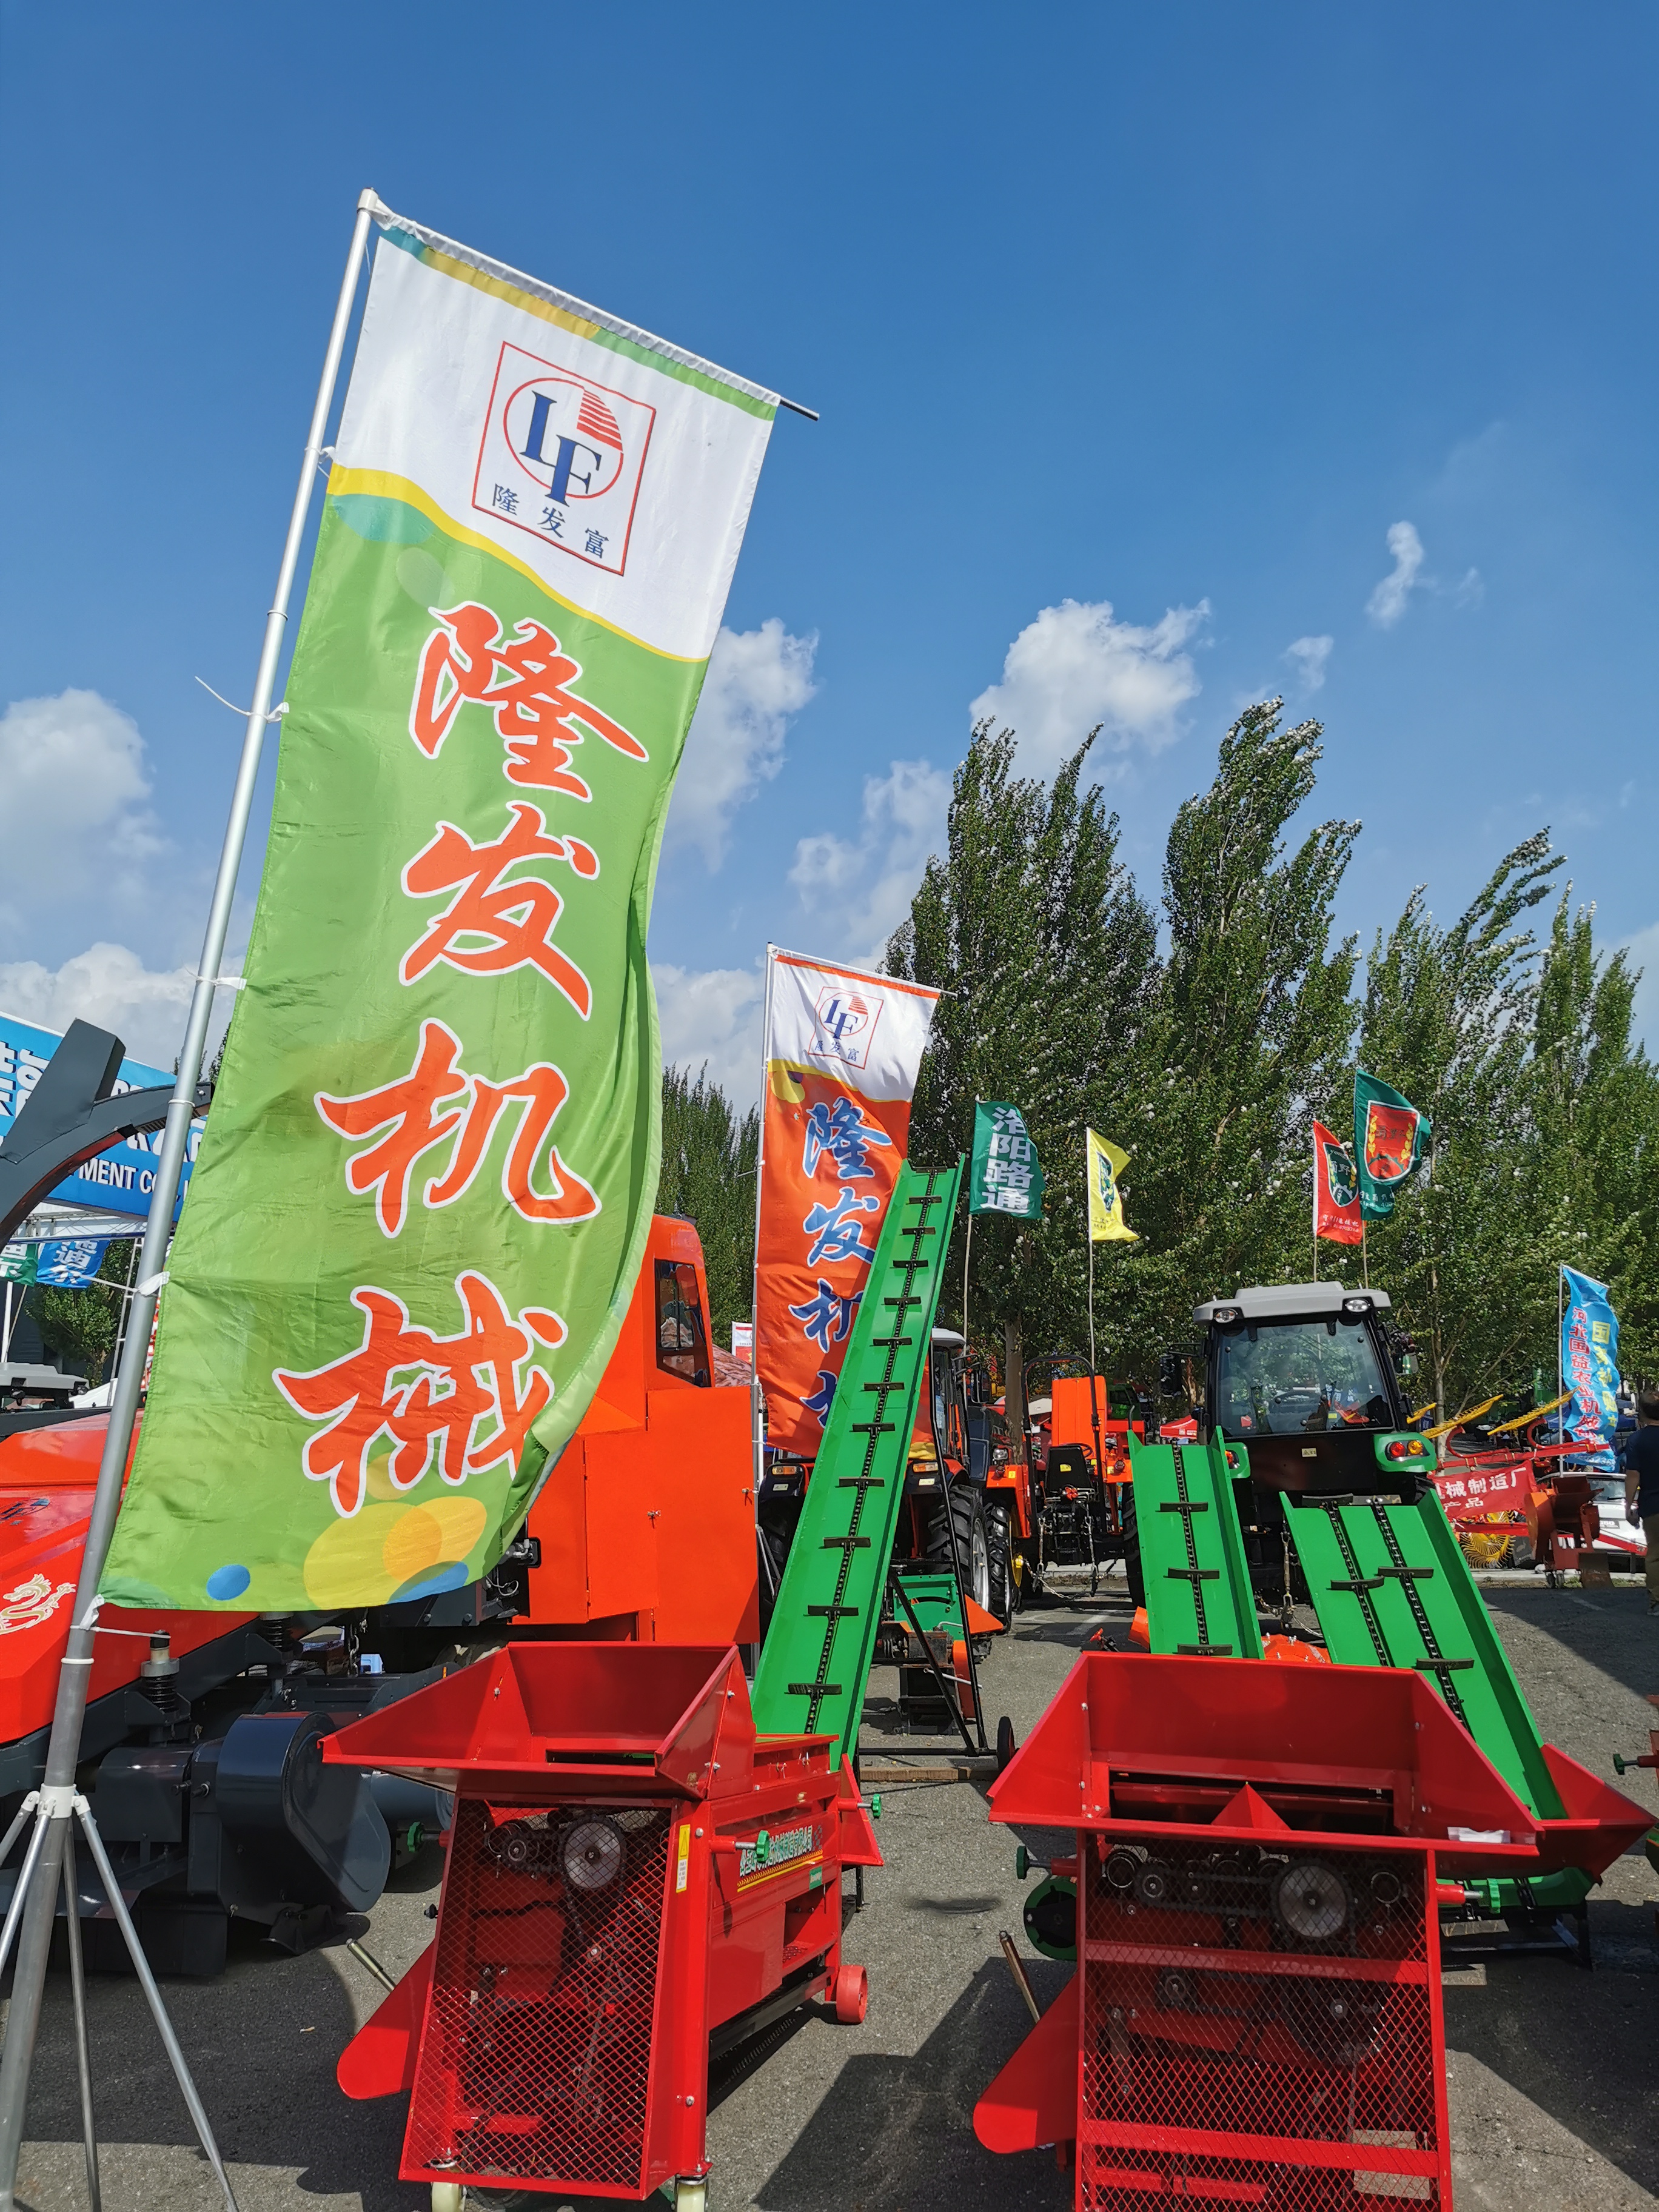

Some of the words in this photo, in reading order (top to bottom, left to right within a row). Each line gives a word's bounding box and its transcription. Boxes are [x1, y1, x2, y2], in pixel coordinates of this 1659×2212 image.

[520, 390, 602, 508] LF
[492, 483, 609, 559] 隆发富
[272, 599, 649, 1518] 隆发机械
[814, 1040, 859, 1062] 隆发富
[823, 999, 859, 1041] LF
[980, 1106, 1034, 1214] 洛阳路通
